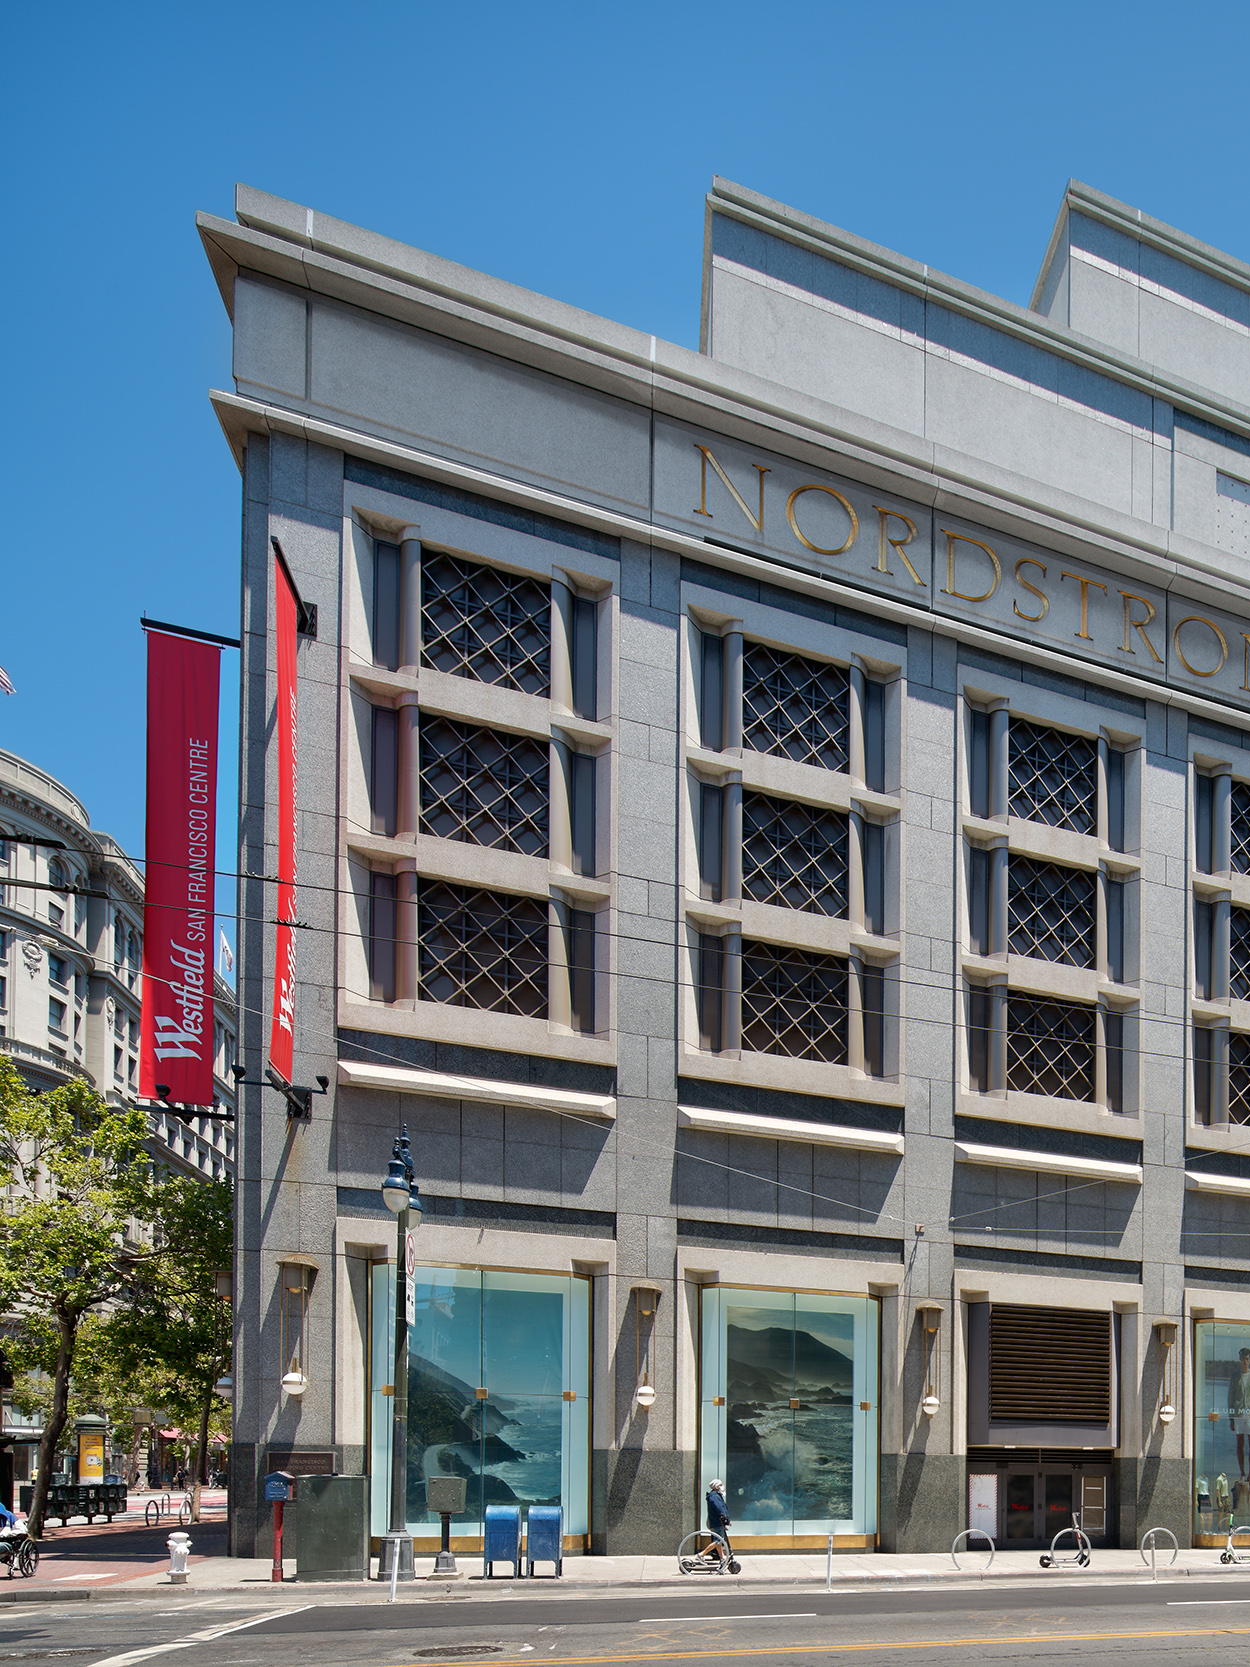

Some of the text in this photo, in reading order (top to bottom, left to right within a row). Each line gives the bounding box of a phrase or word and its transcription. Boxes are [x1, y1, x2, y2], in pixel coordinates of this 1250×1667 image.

[153, 738, 208, 1063] Westfield SAN FRANCISCO CENTRE
[279, 897, 297, 1037] Westfield
